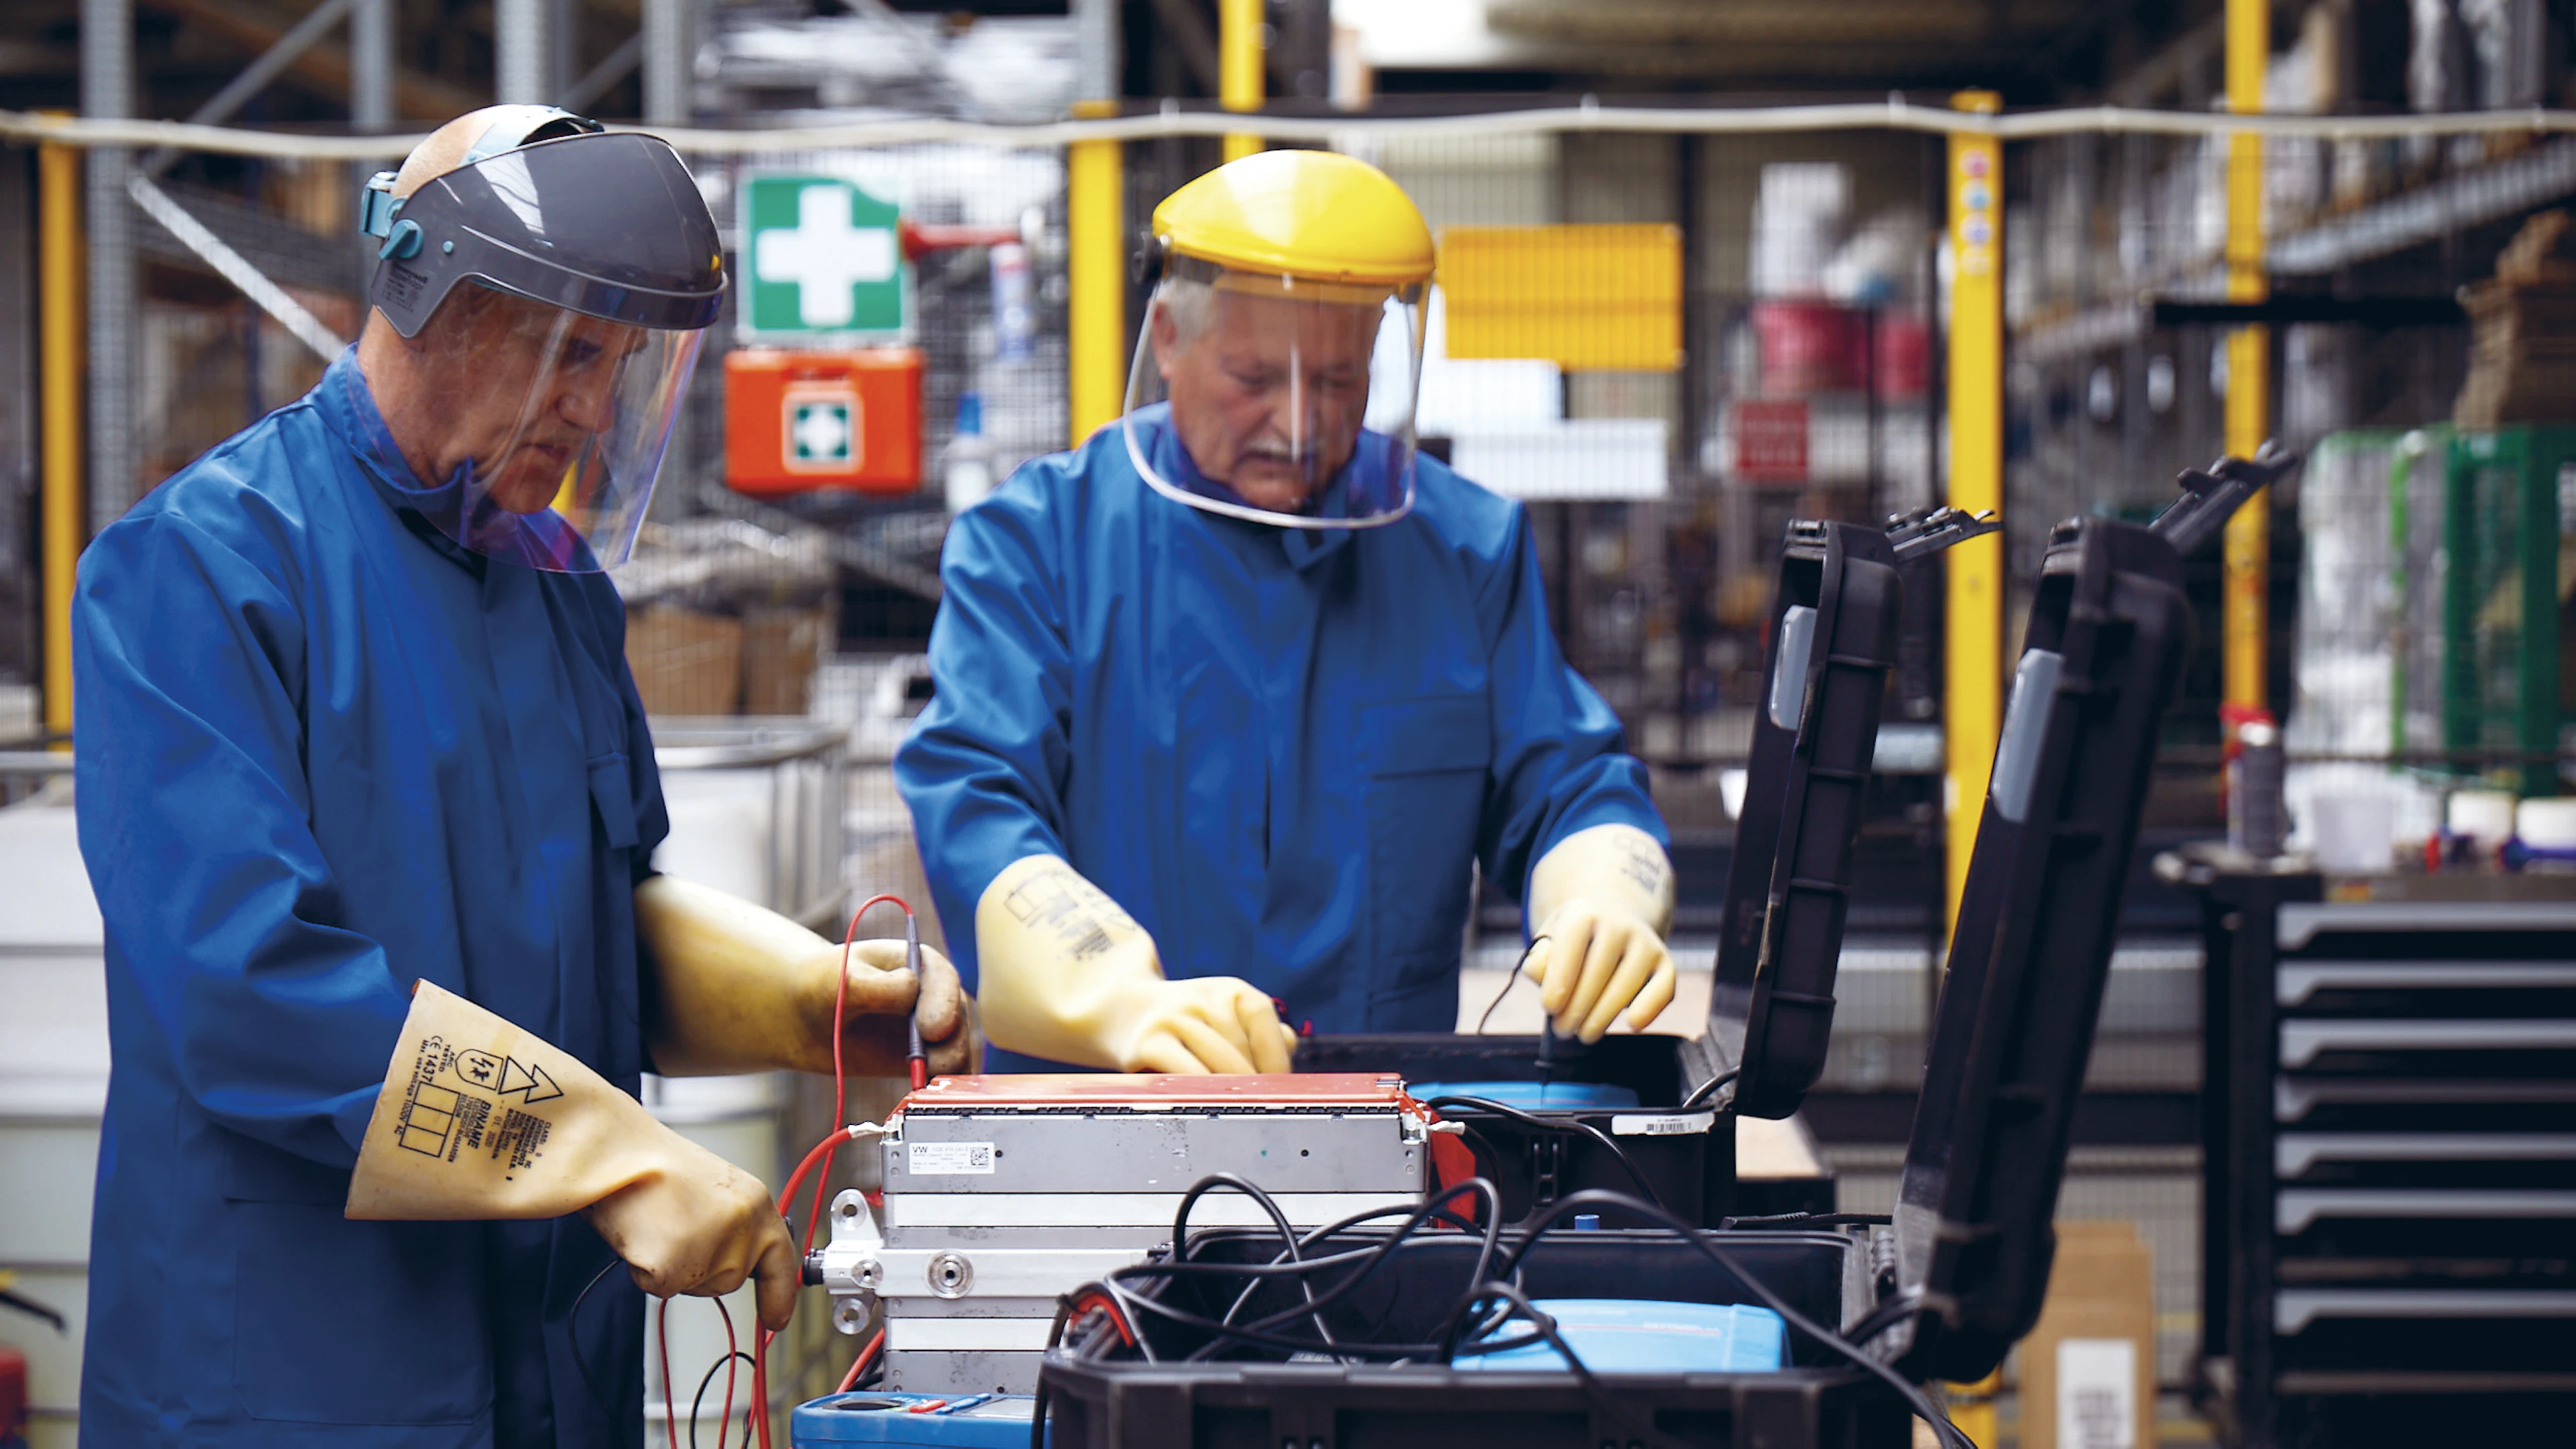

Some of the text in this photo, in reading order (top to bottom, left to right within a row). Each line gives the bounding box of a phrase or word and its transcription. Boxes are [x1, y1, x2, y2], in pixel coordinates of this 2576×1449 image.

[415, 1057, 423, 1069] use
[420, 1052, 439, 1083] 1437
[437, 1043, 451, 1073] TESTED
[445, 1051, 456, 1069] ARC
[406, 1070, 419, 1096] voltage
[398, 1098, 411, 1122] 1000V
[394, 1124, 404, 1136] AC
[466, 1099, 492, 1149] BINAME
